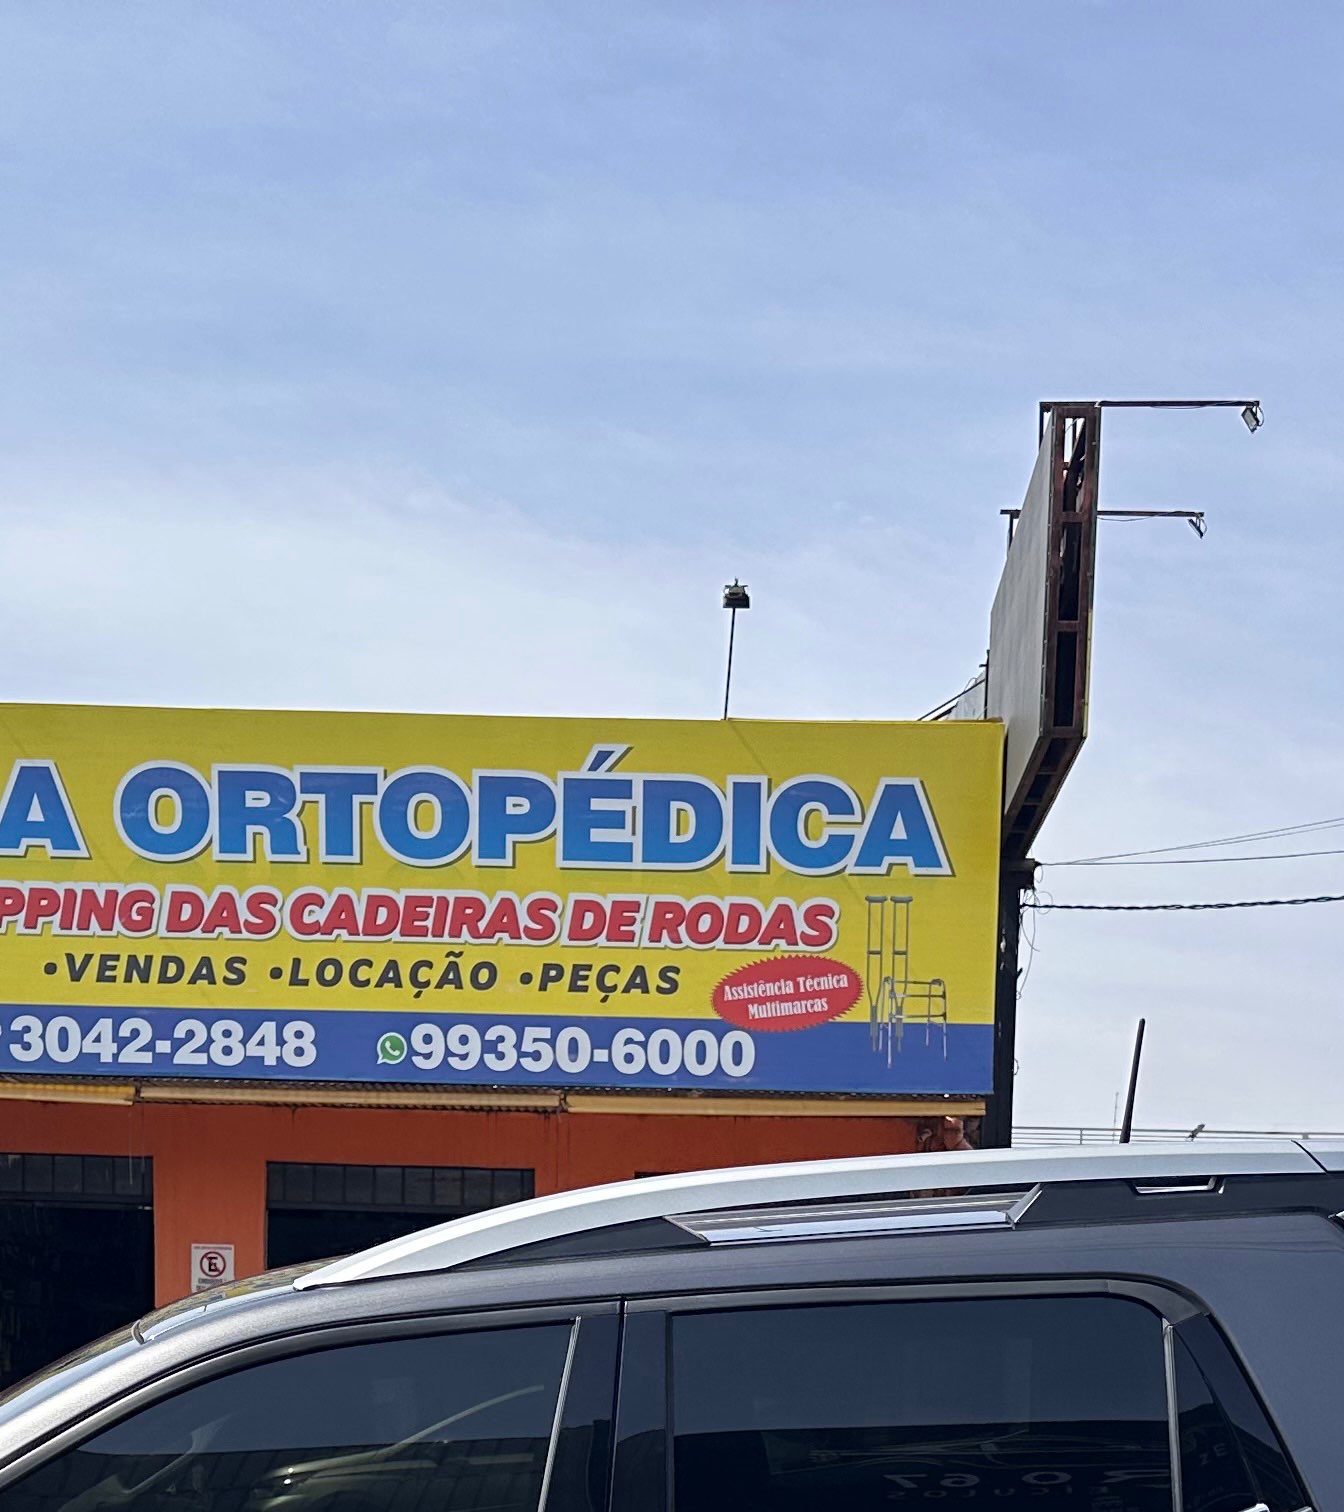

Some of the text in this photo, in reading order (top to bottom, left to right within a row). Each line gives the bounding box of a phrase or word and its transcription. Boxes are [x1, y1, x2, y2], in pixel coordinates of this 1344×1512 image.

[114, 744, 953, 876] ORTOPÉDICA
[164, 890, 280, 936] DAS
[288, 893, 556, 942] CADEIRAS
[567, 896, 644, 943] DE
[654, 897, 835, 946] RODAS
[723, 973, 849, 1002] Assistência Técnica
[747, 997, 829, 1020] Multimarcas
[8, 1014, 756, 1078] 3042-2848 99350-6000
